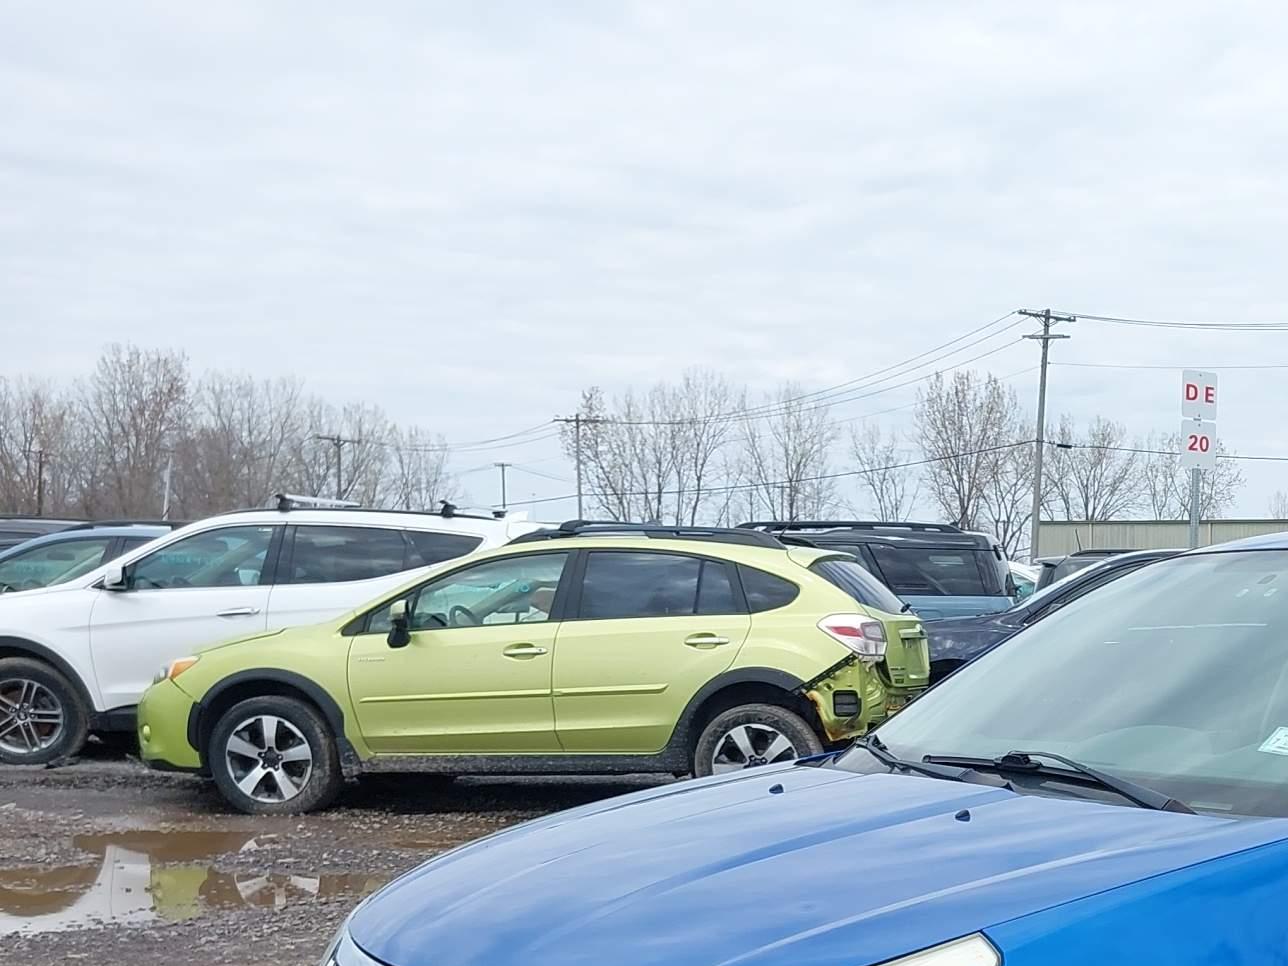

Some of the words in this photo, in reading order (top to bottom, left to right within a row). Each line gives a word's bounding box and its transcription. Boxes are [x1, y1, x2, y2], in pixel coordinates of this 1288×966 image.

[1186, 383, 1198, 401] D
[1205, 386, 1215, 404] E
[1188, 434, 1210, 453] 20
